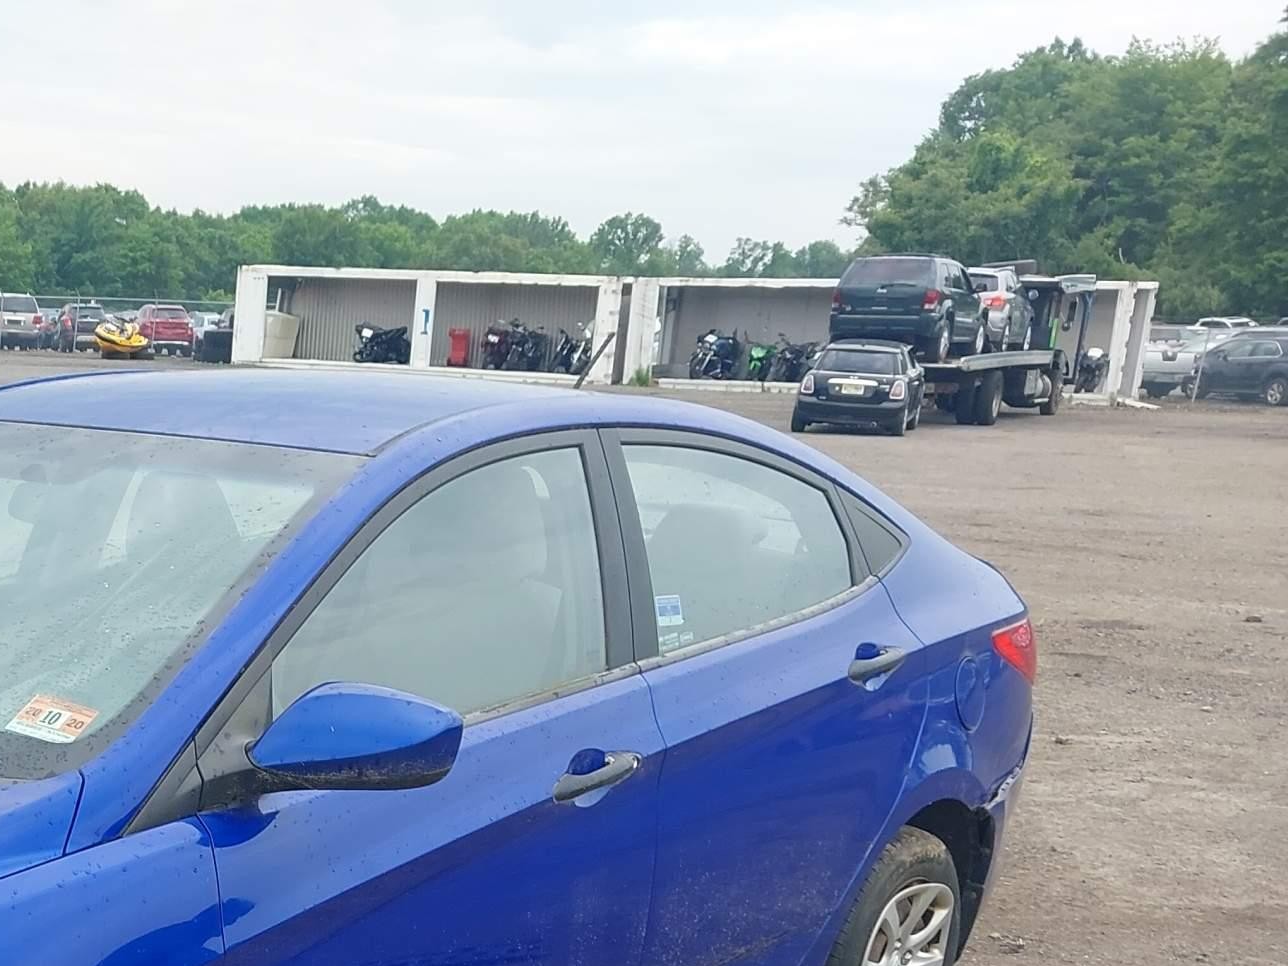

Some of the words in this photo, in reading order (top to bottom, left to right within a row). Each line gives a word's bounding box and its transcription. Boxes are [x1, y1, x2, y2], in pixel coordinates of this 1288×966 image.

[421, 308, 431, 336] 1
[39, 710, 62, 726] 10
[65, 718, 85, 730] 20
